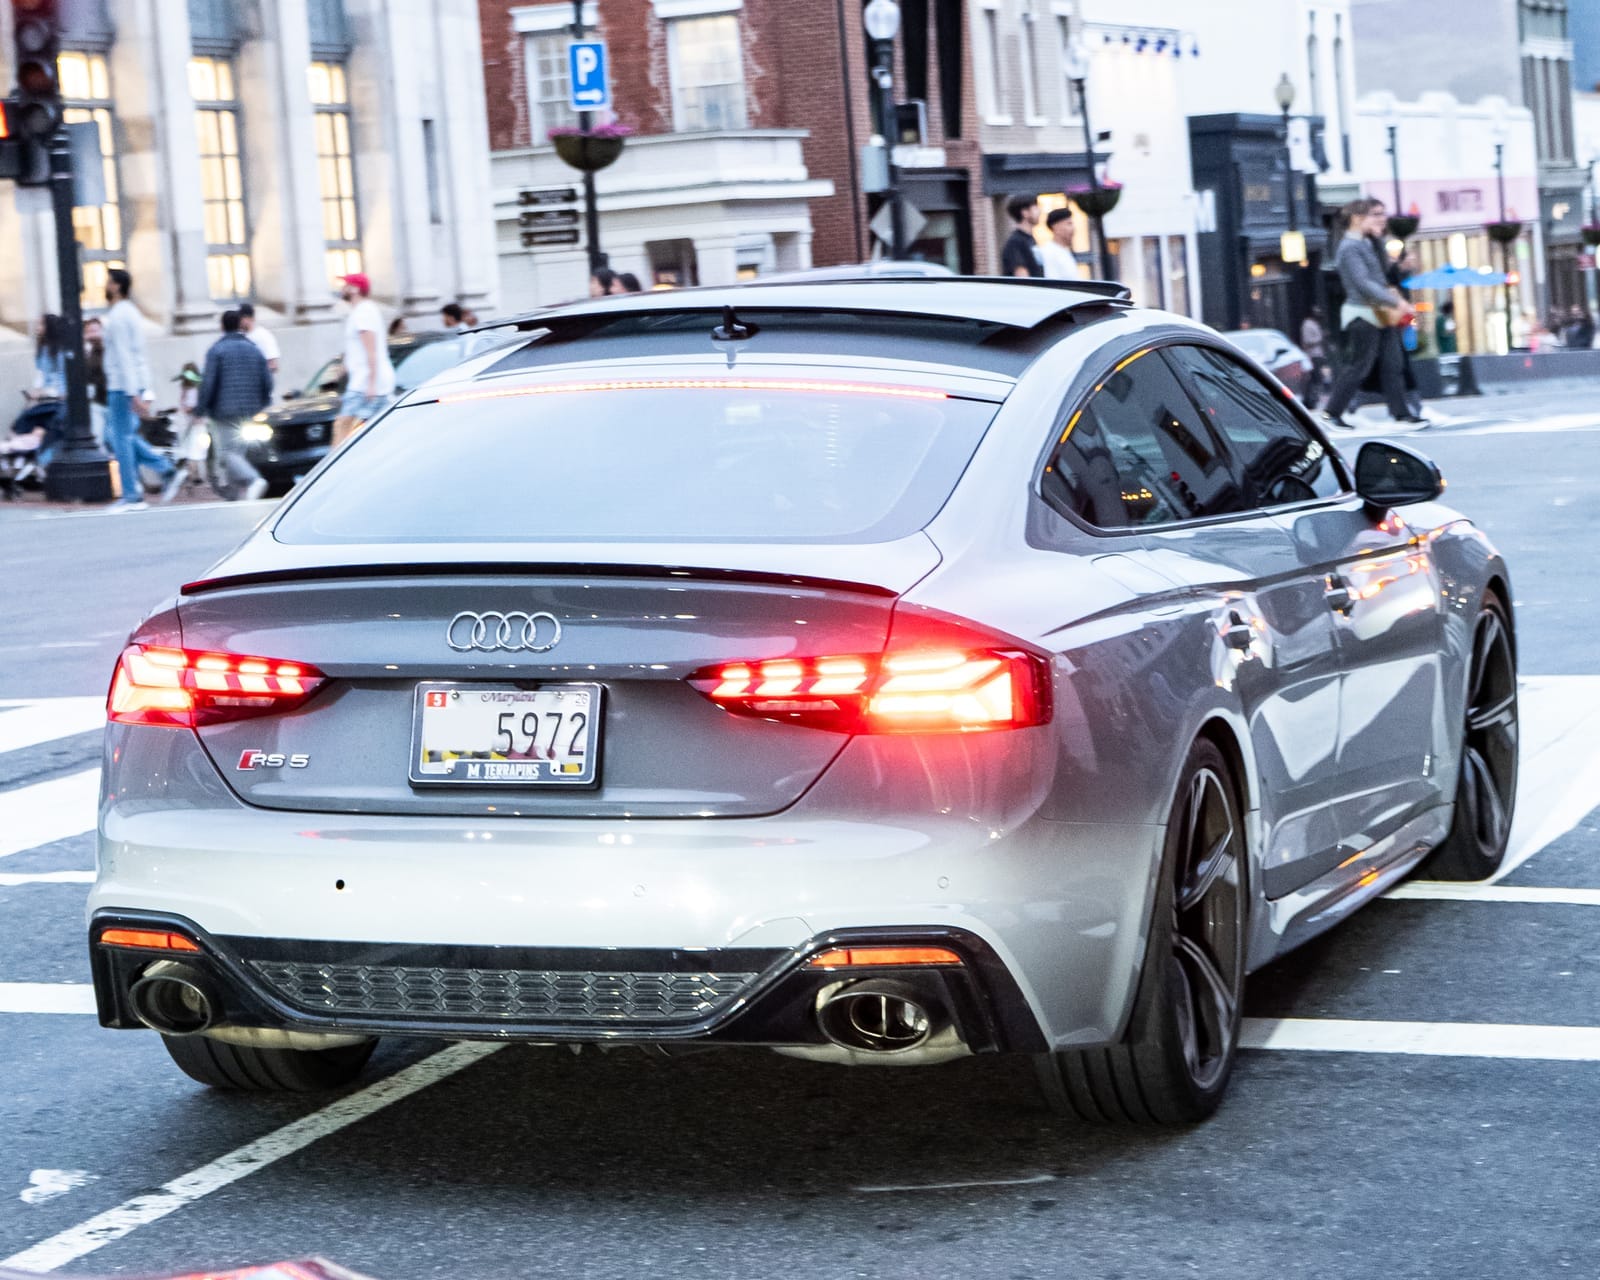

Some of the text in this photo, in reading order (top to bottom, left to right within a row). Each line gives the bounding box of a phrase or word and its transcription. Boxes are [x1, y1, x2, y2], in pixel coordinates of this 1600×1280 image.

[576, 46, 598, 86] P
[498, 712, 586, 757] 5972
[483, 763, 539, 778] TERRAPINS
